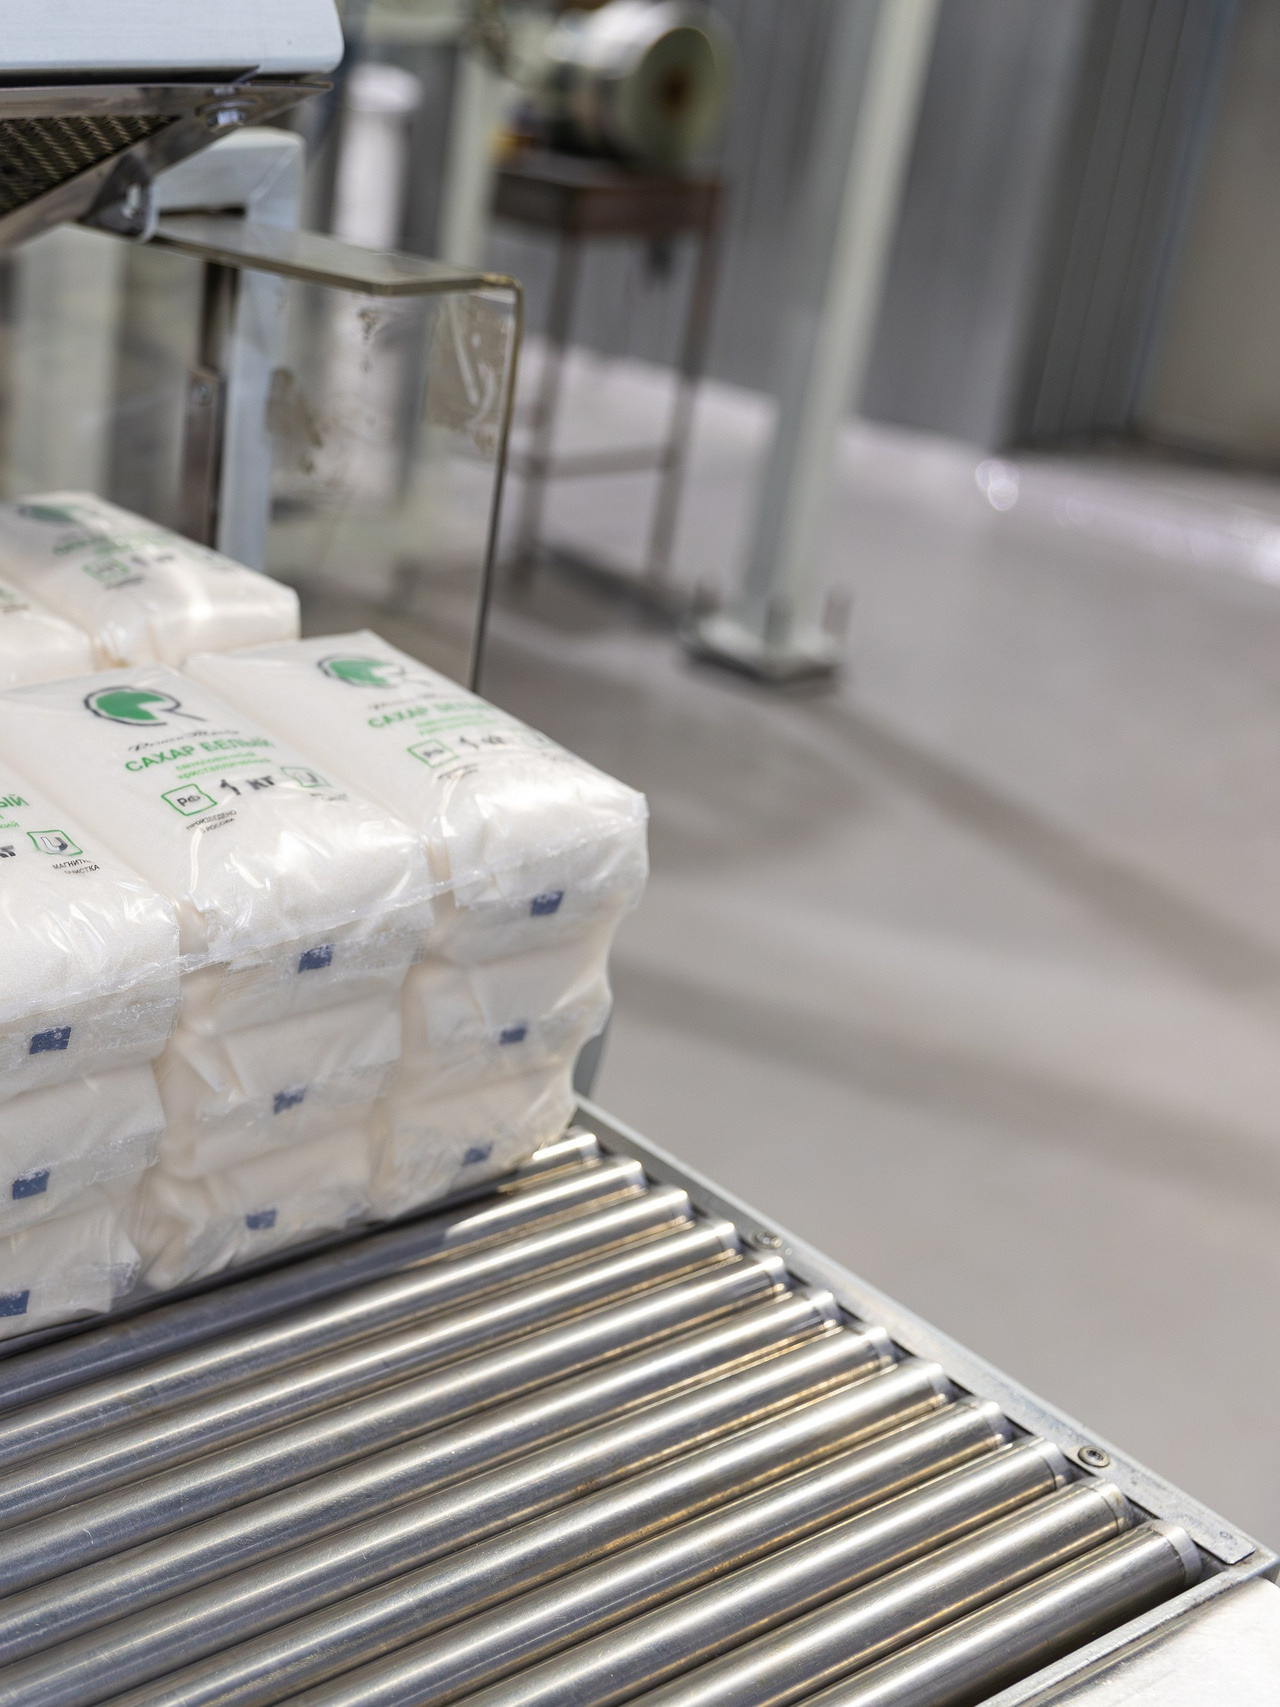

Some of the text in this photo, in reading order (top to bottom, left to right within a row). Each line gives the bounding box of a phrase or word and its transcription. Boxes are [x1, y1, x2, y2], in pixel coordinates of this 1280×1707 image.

[125, 736, 274, 772] САХАР БЕЛЫЙ
[219, 778, 241, 796] 1
